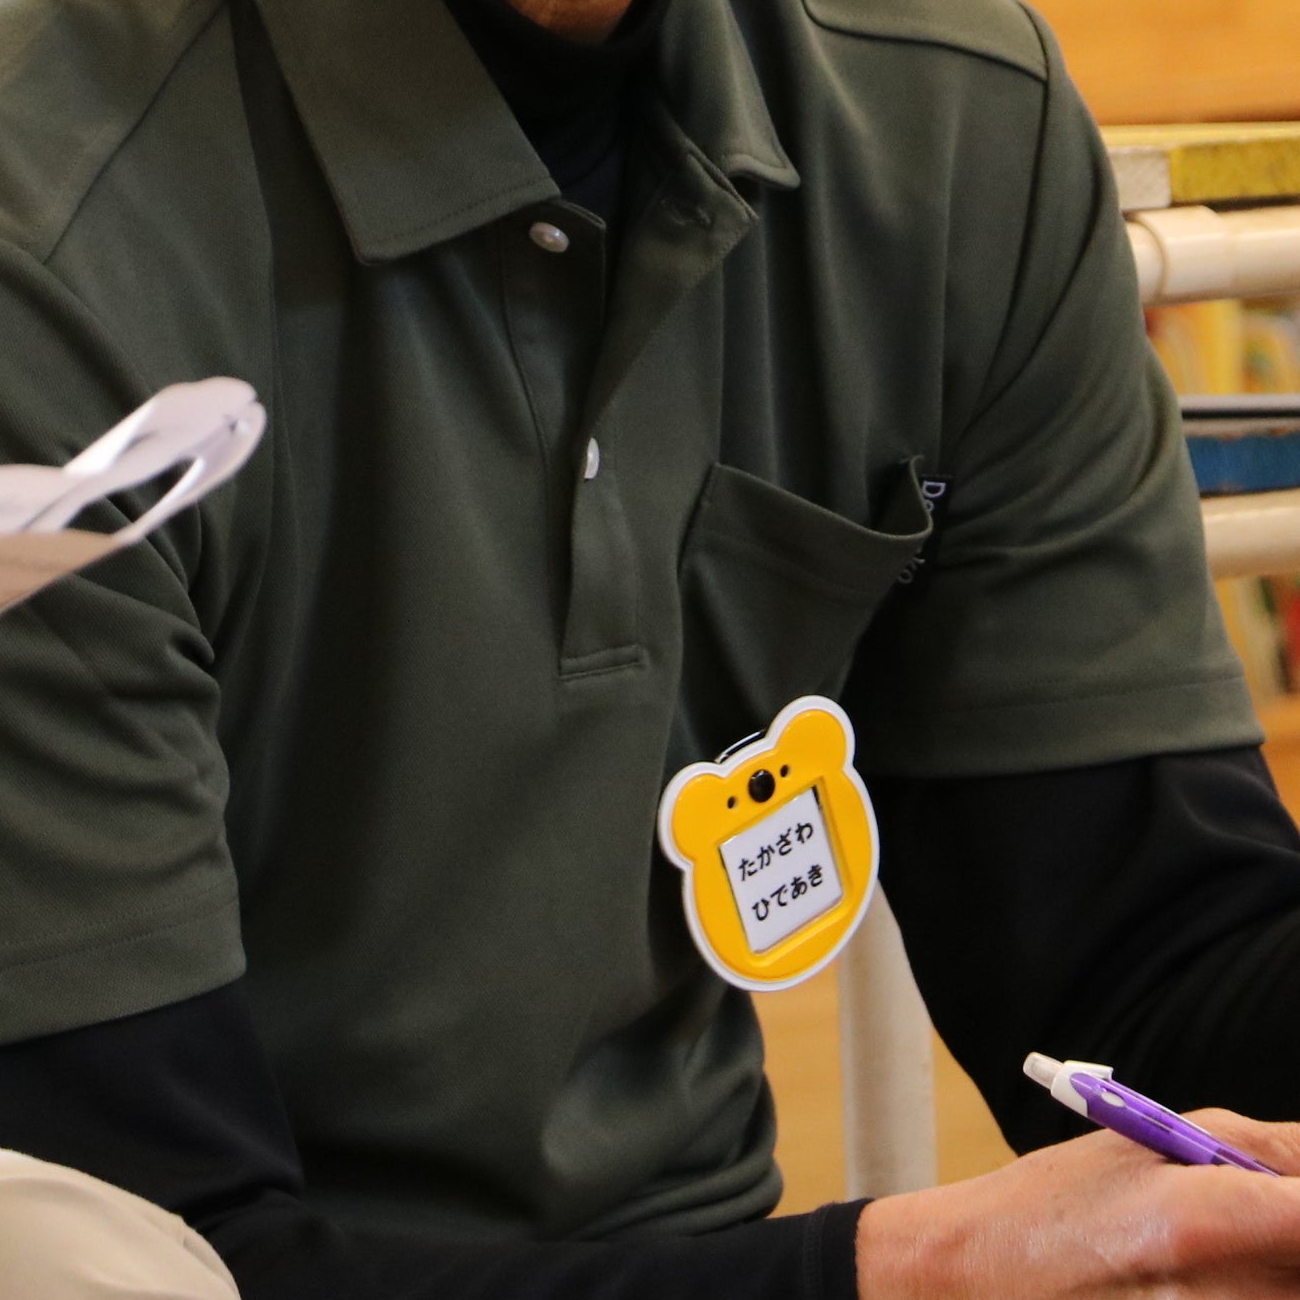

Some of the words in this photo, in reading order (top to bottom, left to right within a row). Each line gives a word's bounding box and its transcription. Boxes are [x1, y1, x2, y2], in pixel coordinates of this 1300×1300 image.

[738, 822, 813, 881] たかざわ
[752, 864, 823, 921] ひであき
